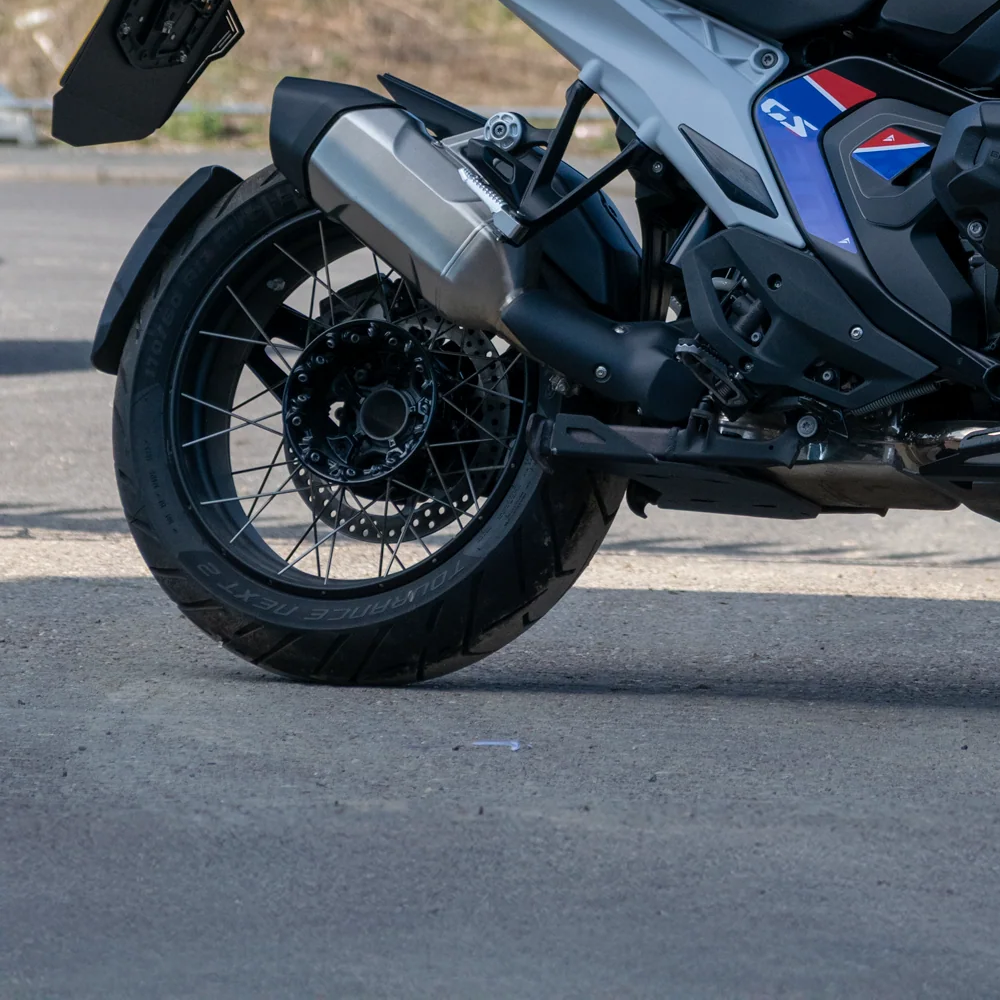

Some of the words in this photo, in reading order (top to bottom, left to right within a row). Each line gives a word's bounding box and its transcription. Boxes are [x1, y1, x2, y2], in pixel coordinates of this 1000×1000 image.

[760, 98, 819, 138] GS
[196, 562, 223, 577] 2
[216, 581, 300, 617] NEXT
[303, 559, 465, 622] TOURANCE
